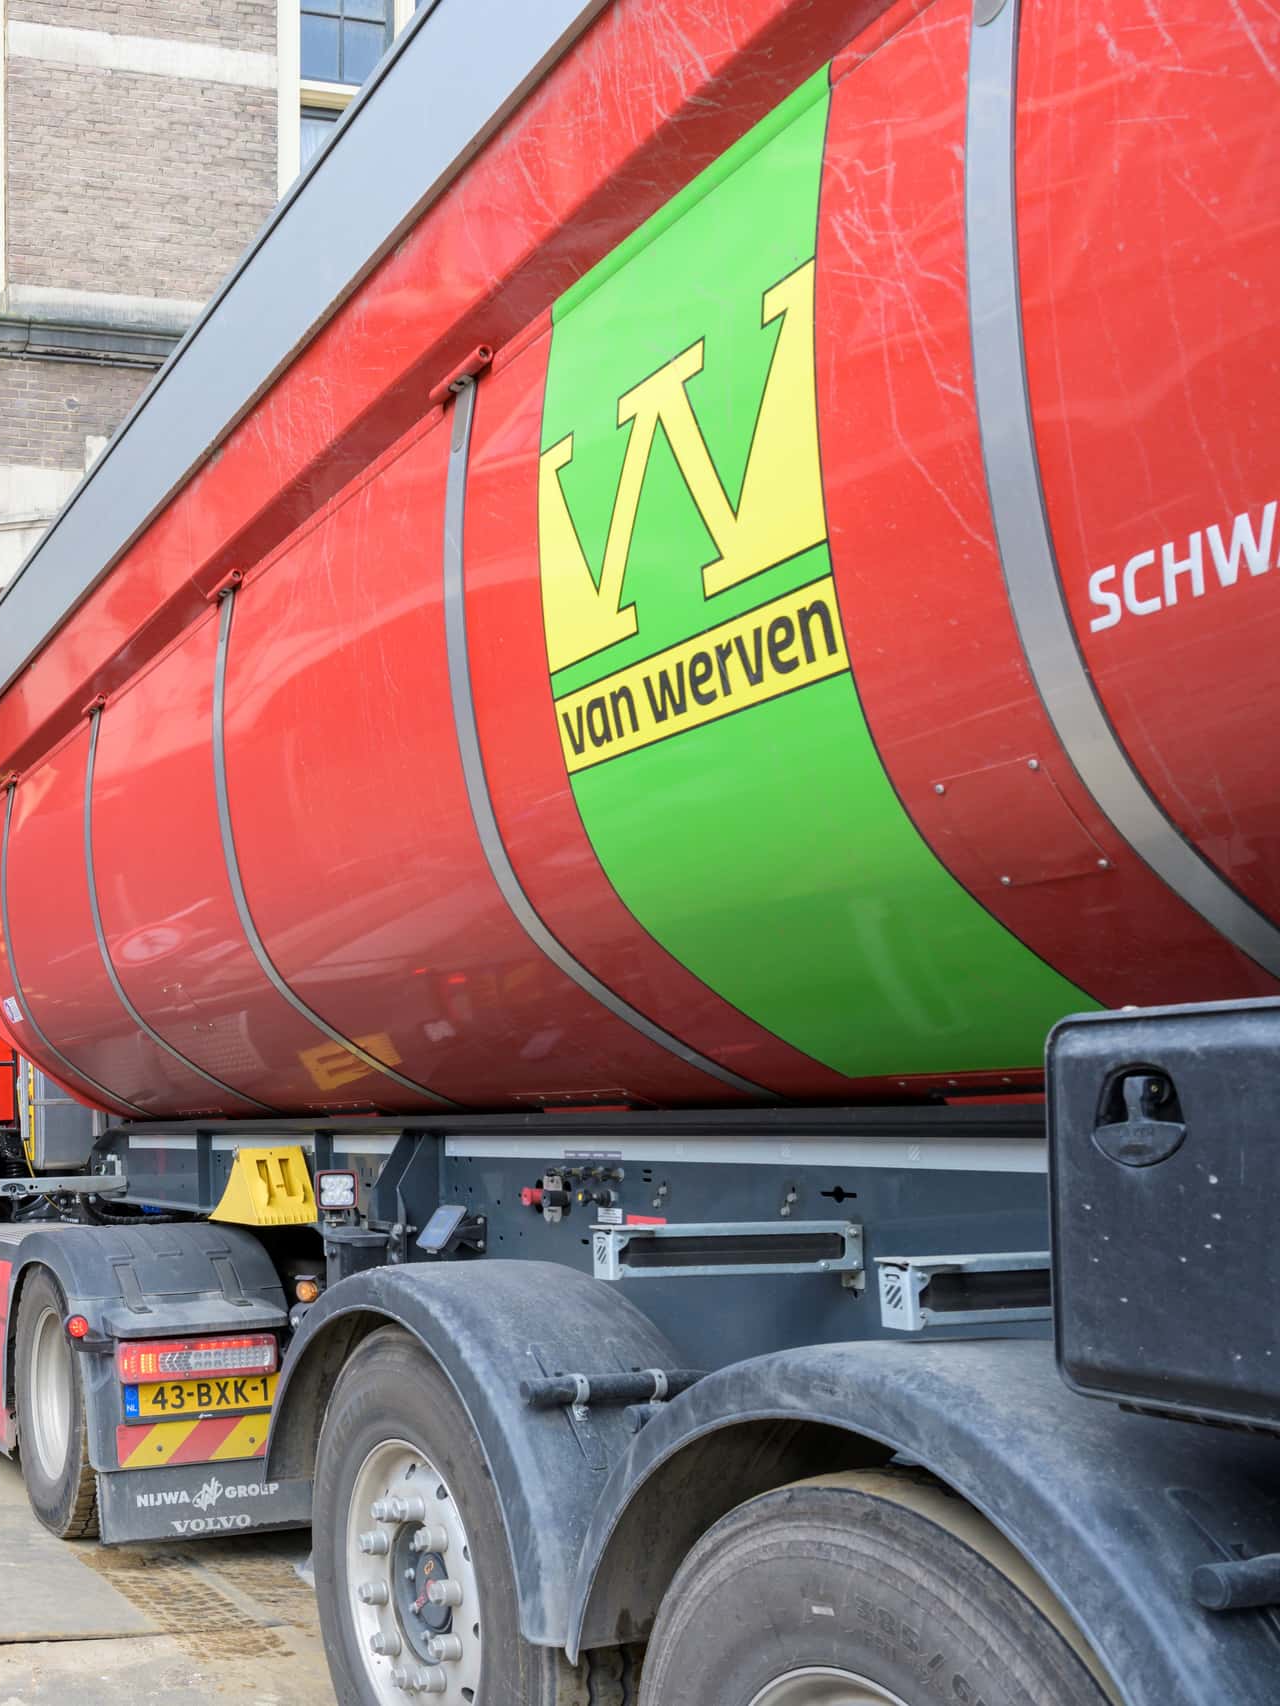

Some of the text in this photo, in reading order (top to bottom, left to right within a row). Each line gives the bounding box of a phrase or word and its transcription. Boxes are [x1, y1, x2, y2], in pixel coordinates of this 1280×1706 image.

[1088, 500, 1280, 633] SCHW
[562, 600, 838, 755] van werven
[152, 1377, 269, 1411] 43-BXK-1
[126, 1404, 138, 1413] NL
[136, 1490, 191, 1508] NIJWA
[171, 1513, 252, 1534] VOLVO
